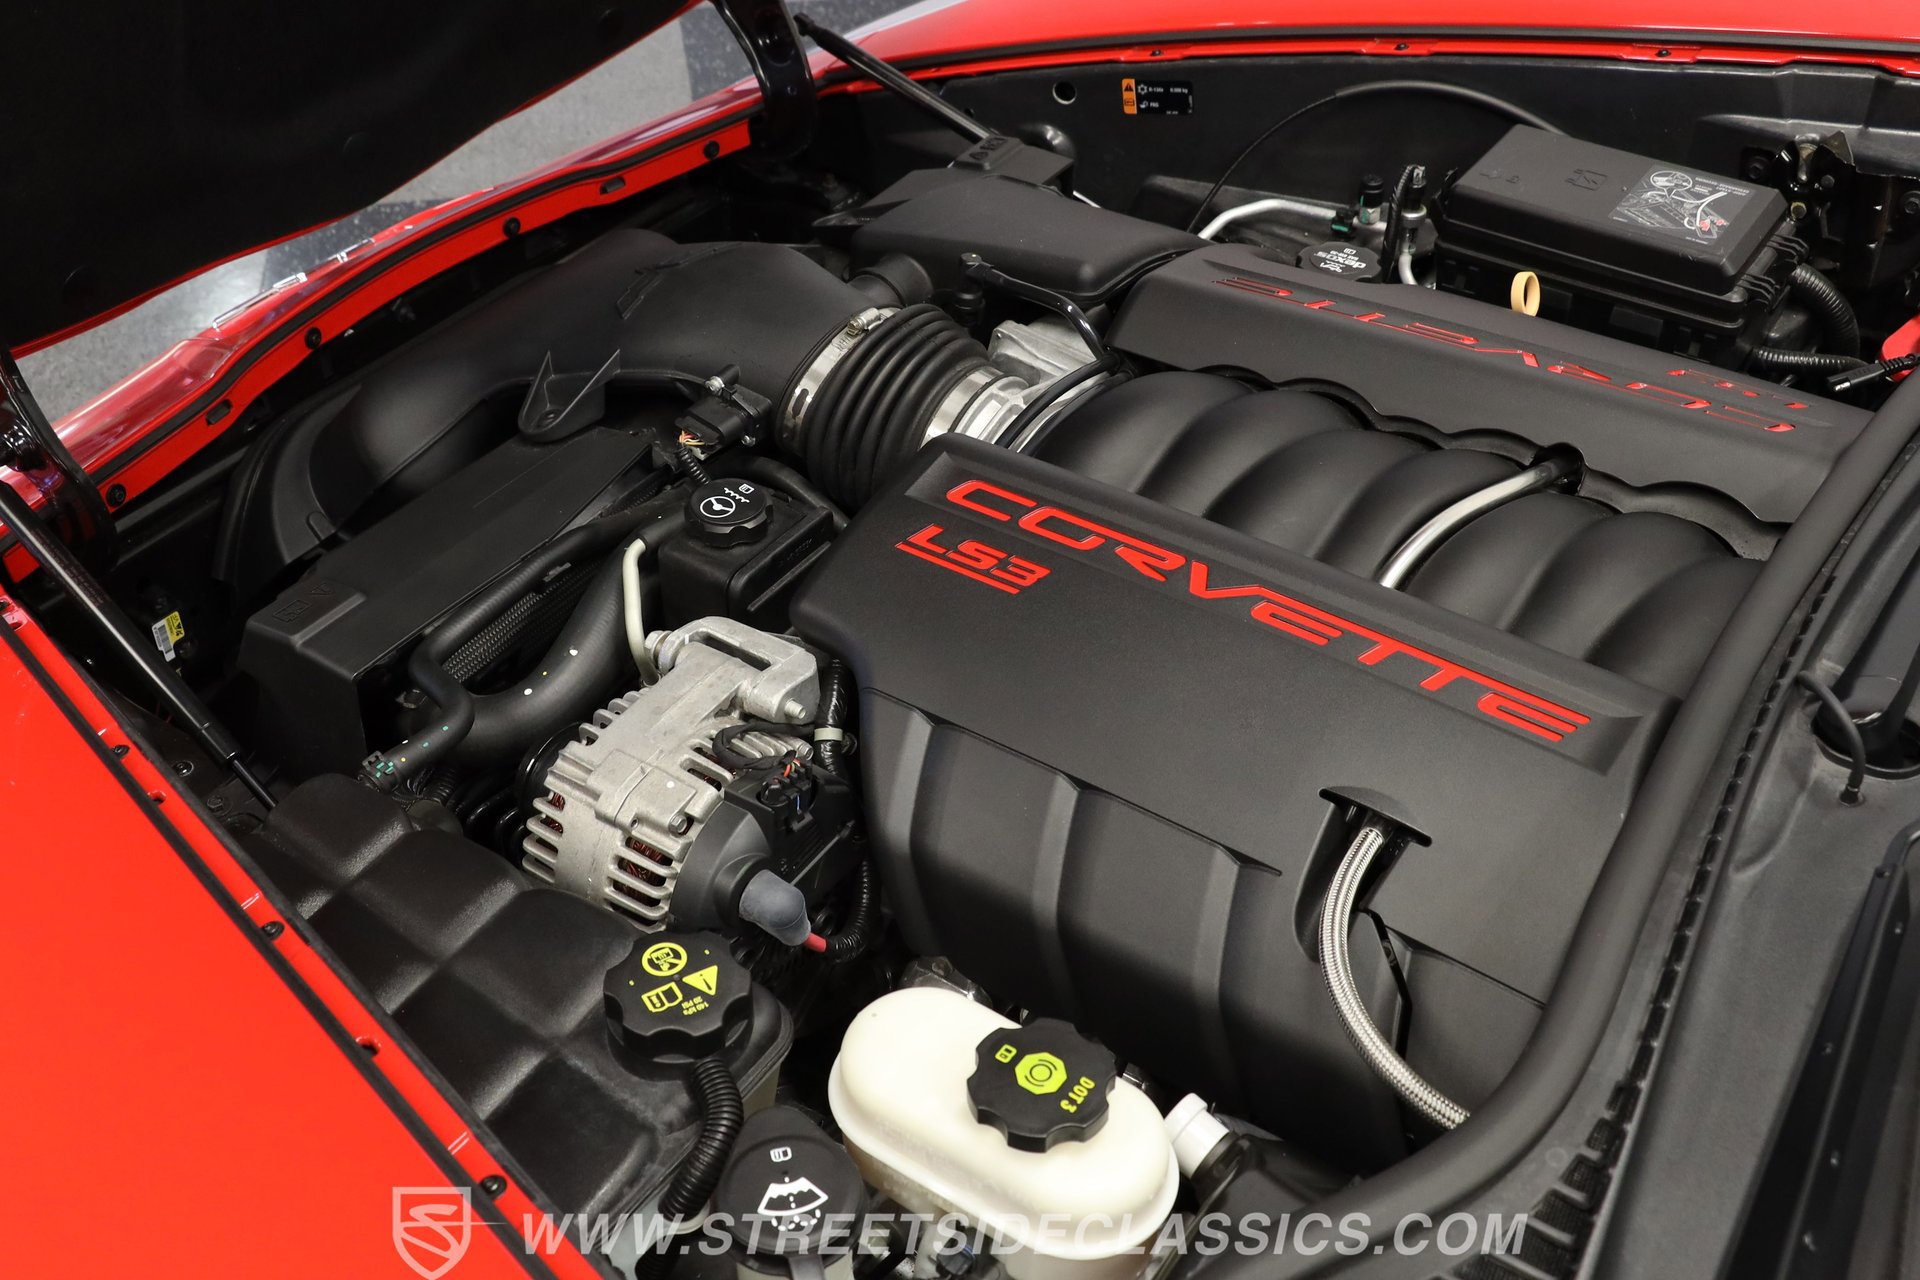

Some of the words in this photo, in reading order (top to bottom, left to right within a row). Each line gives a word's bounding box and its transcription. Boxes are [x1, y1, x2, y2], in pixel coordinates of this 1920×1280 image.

[900, 523, 1052, 590] LS3
[946, 480, 1591, 742] CORVETTE
[1059, 1099, 1078, 1114] 3
[1067, 1076, 1096, 1105] DOT
